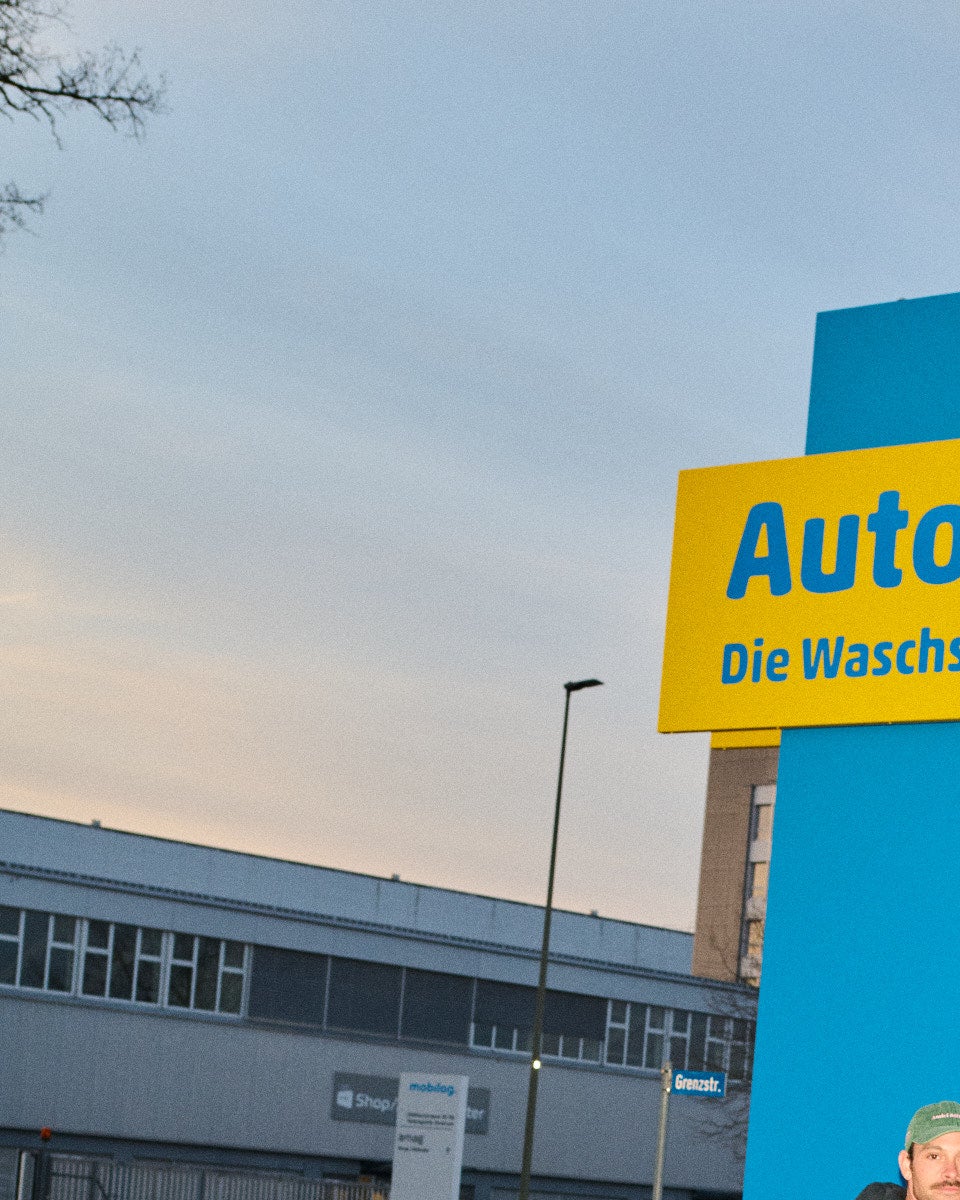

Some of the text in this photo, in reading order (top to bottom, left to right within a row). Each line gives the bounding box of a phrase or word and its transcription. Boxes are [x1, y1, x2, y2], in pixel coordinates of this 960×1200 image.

[721, 637, 789, 686] Die
[409, 1081, 455, 1097] mobilog
[675, 1073, 721, 1092] Grenzstr.
